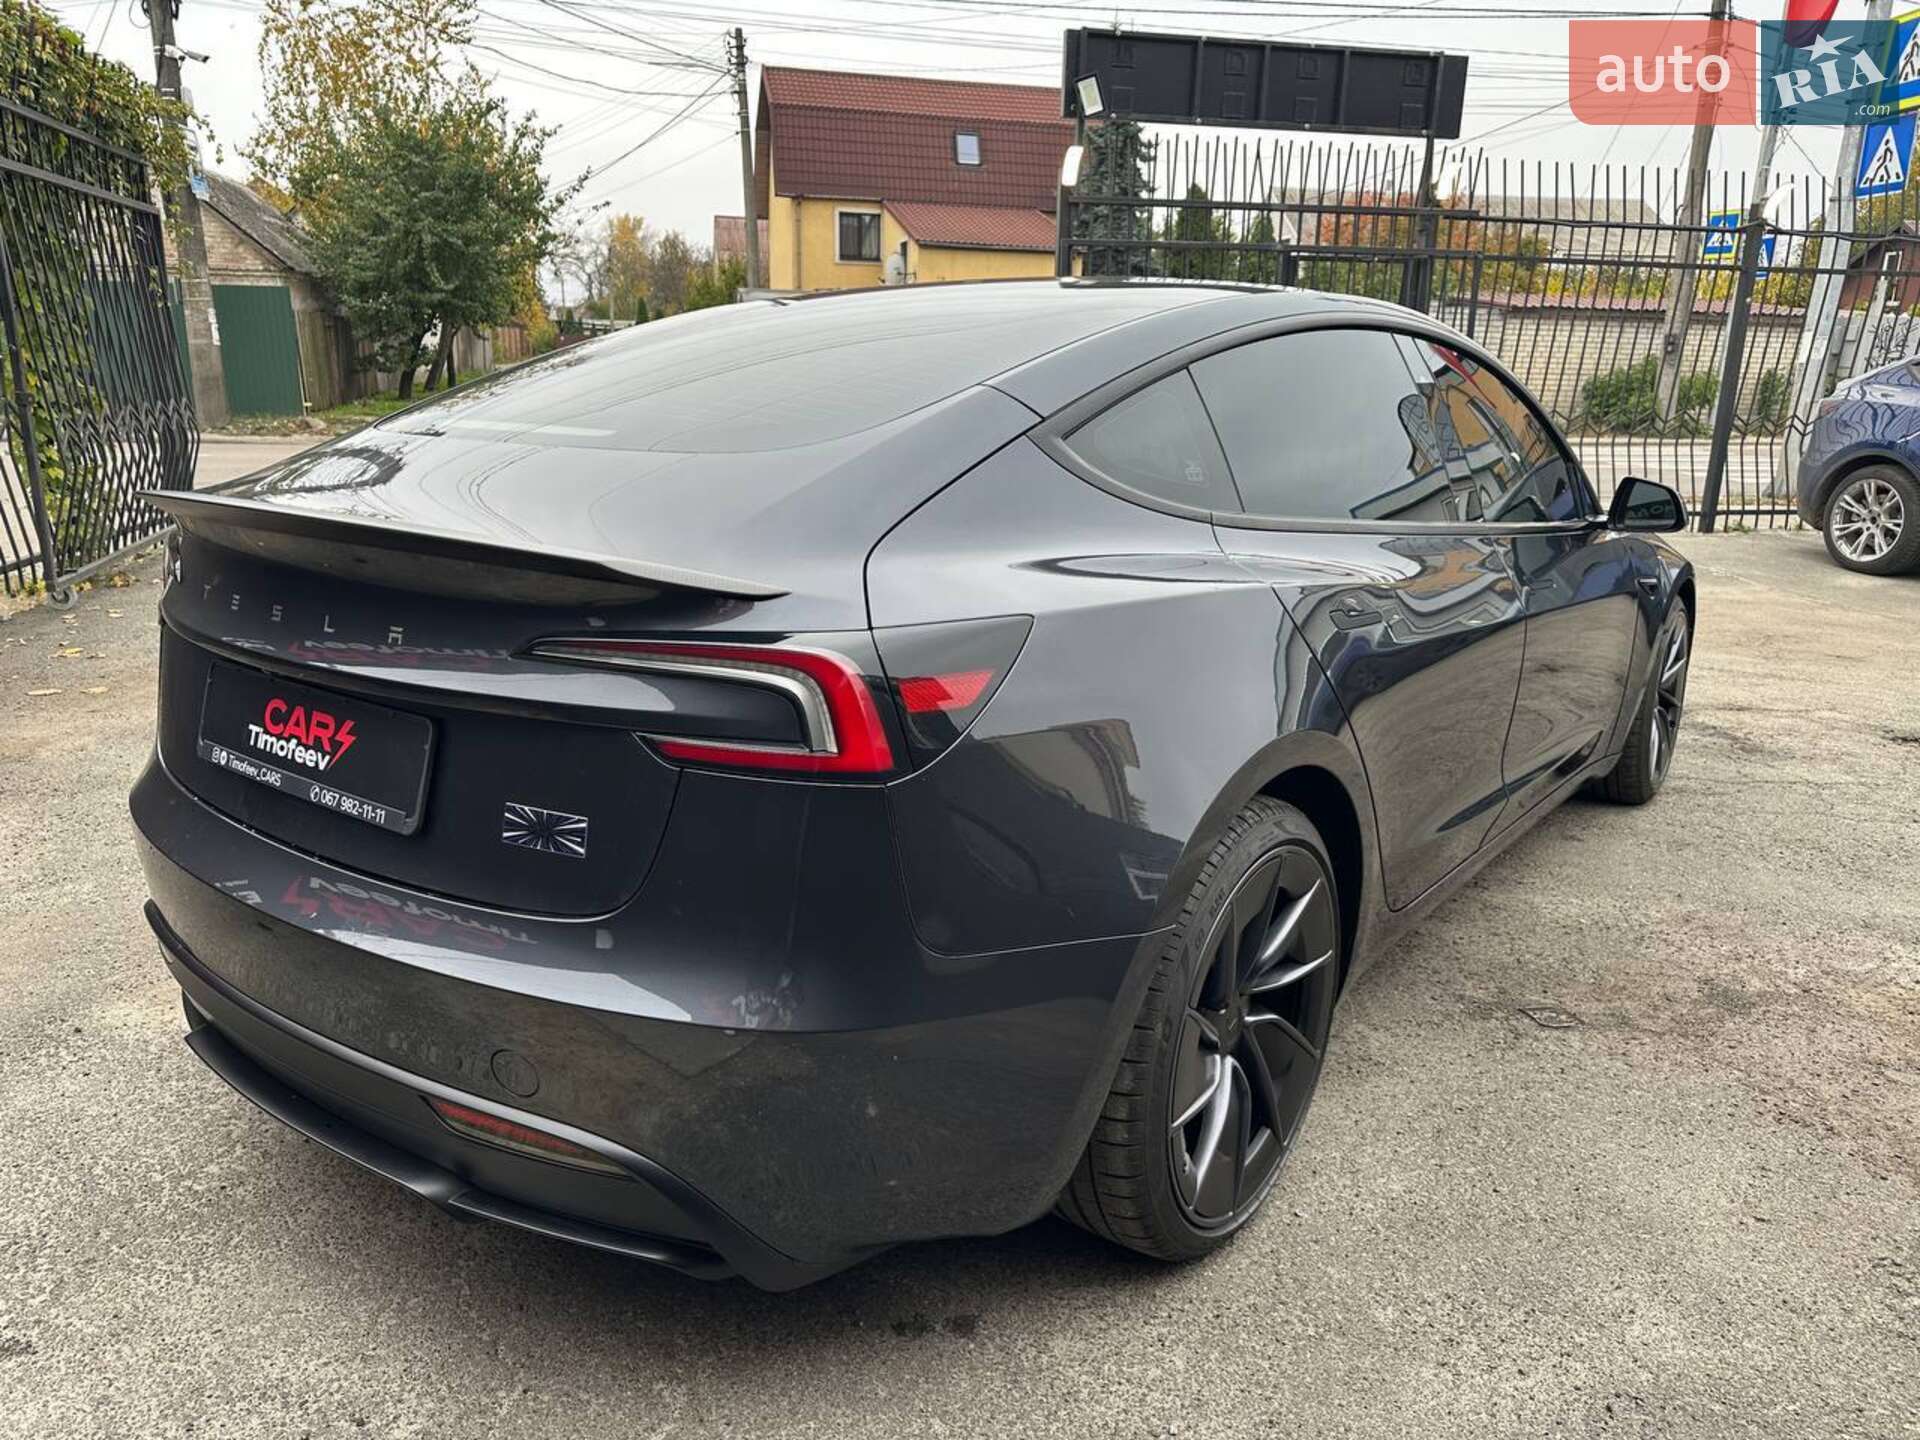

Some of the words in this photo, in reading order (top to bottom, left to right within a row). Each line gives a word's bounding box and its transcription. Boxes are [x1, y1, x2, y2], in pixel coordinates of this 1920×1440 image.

[248, 723, 331, 771] Timofeev
[320, 789, 340, 808] 067
[341, 796, 386, 825] 982-11-11
